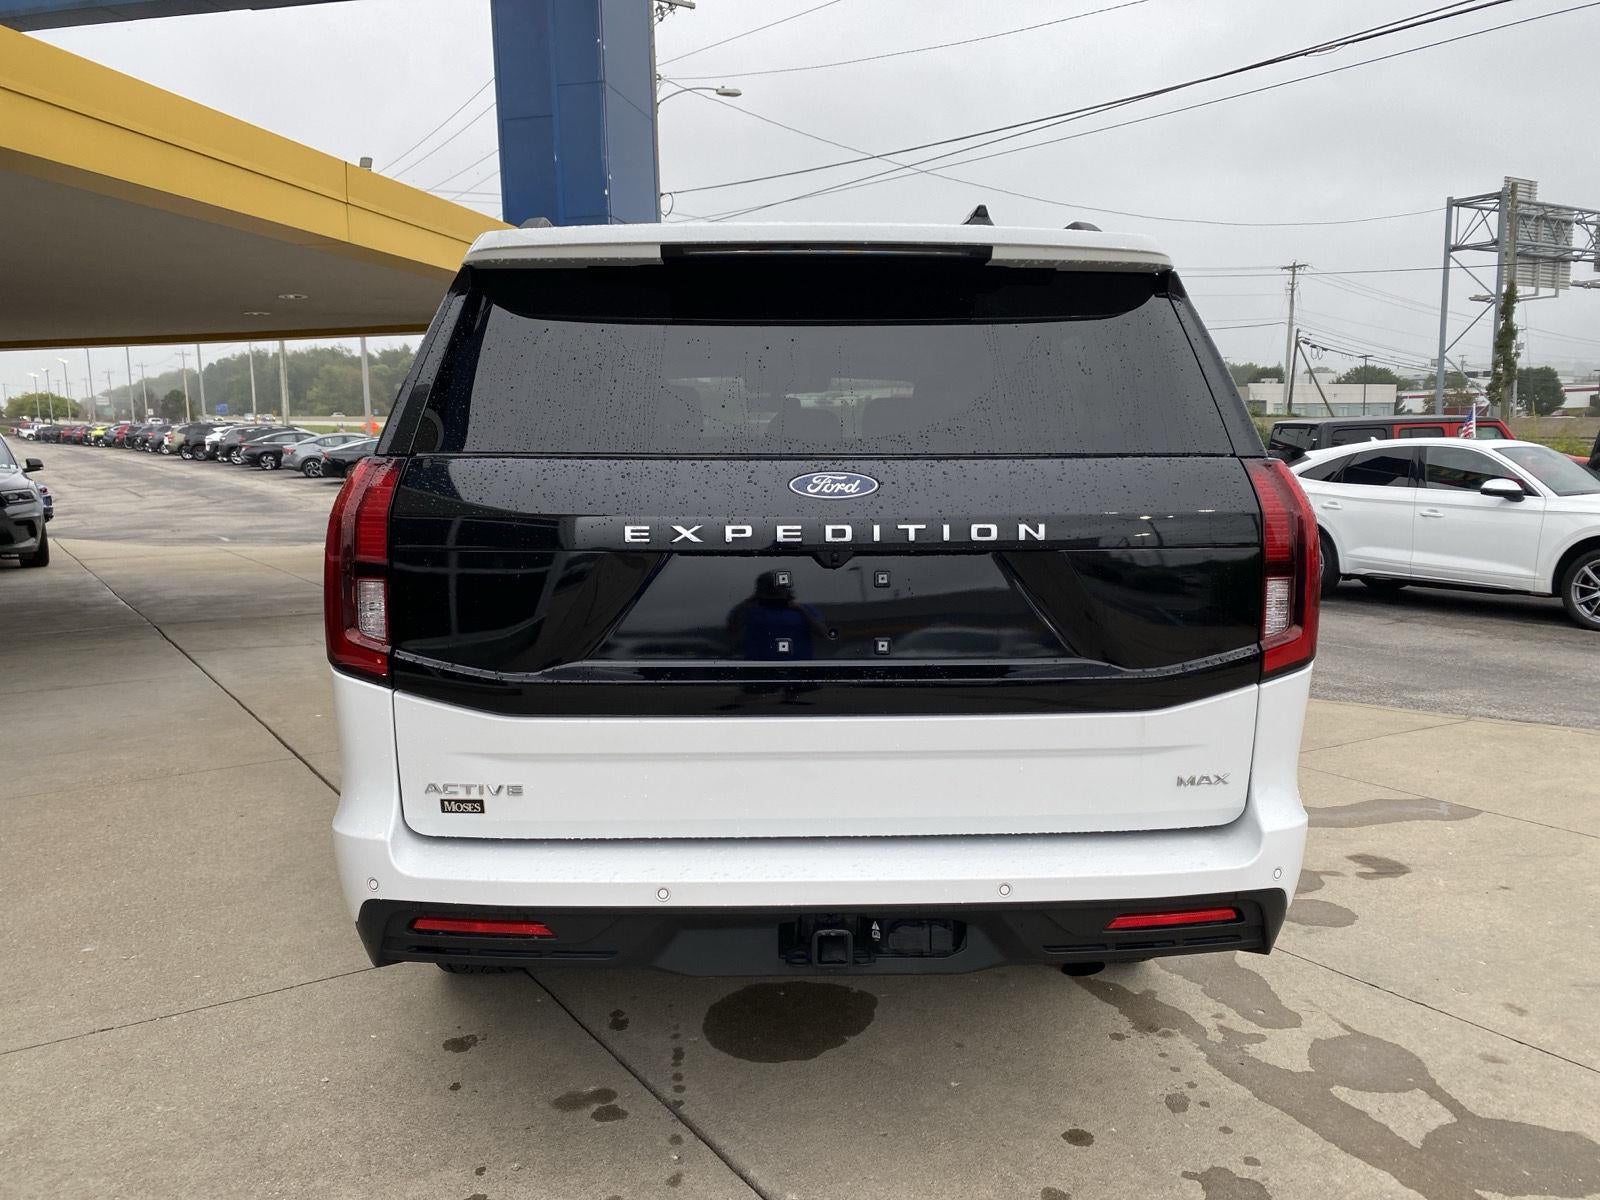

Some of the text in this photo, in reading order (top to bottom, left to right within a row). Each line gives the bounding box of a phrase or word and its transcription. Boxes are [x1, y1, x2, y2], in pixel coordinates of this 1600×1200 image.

[806, 475, 860, 493] Ford
[624, 523, 1046, 543] EXPEDITION
[1176, 773, 1231, 787] MAX
[424, 783, 524, 796] ACTIVE
